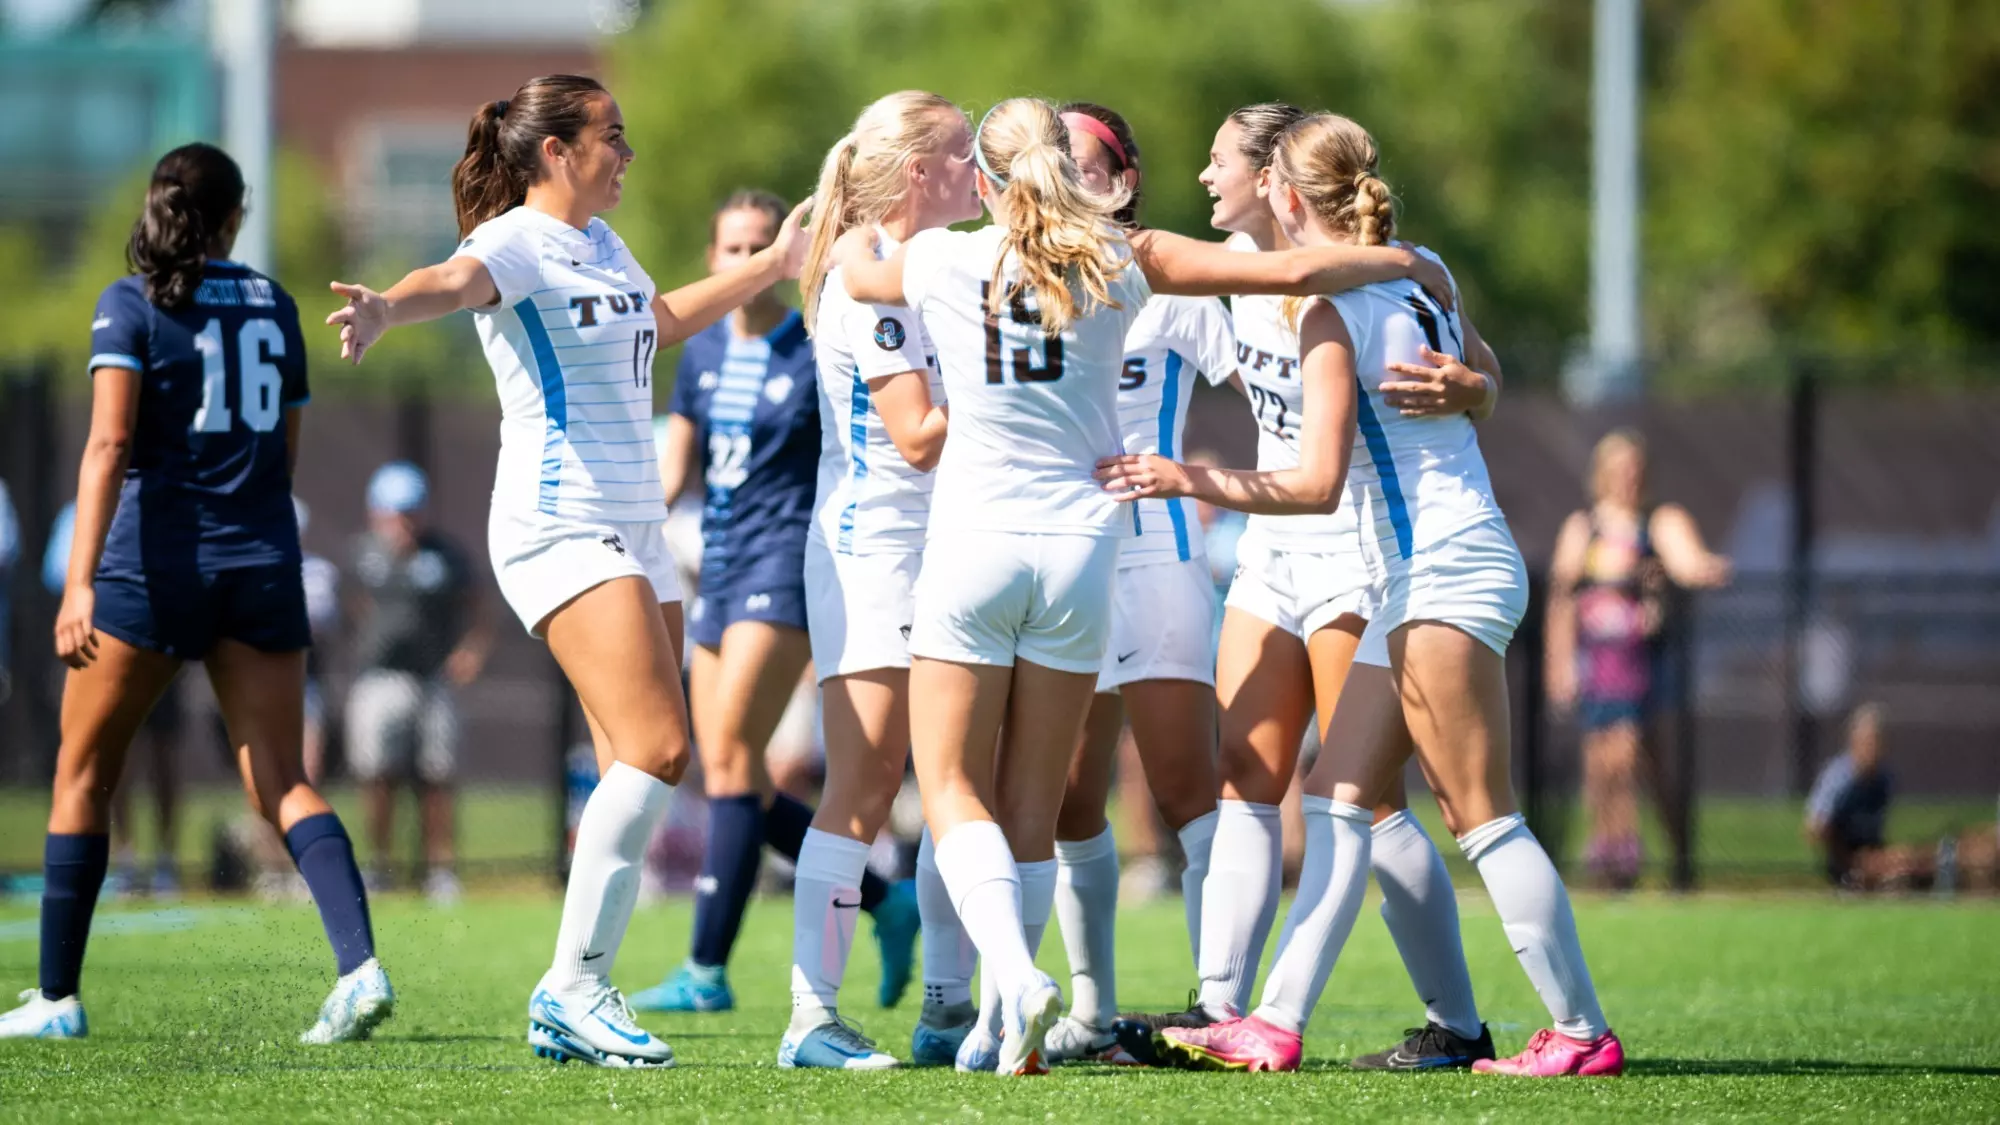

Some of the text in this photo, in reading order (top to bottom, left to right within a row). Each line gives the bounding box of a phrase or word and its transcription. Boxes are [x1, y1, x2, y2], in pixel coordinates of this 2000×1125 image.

[570, 291, 648, 328] TUF
[193, 318, 286, 433] 16
[634, 329, 655, 389] 17
[1236, 339, 1298, 380] UFT
